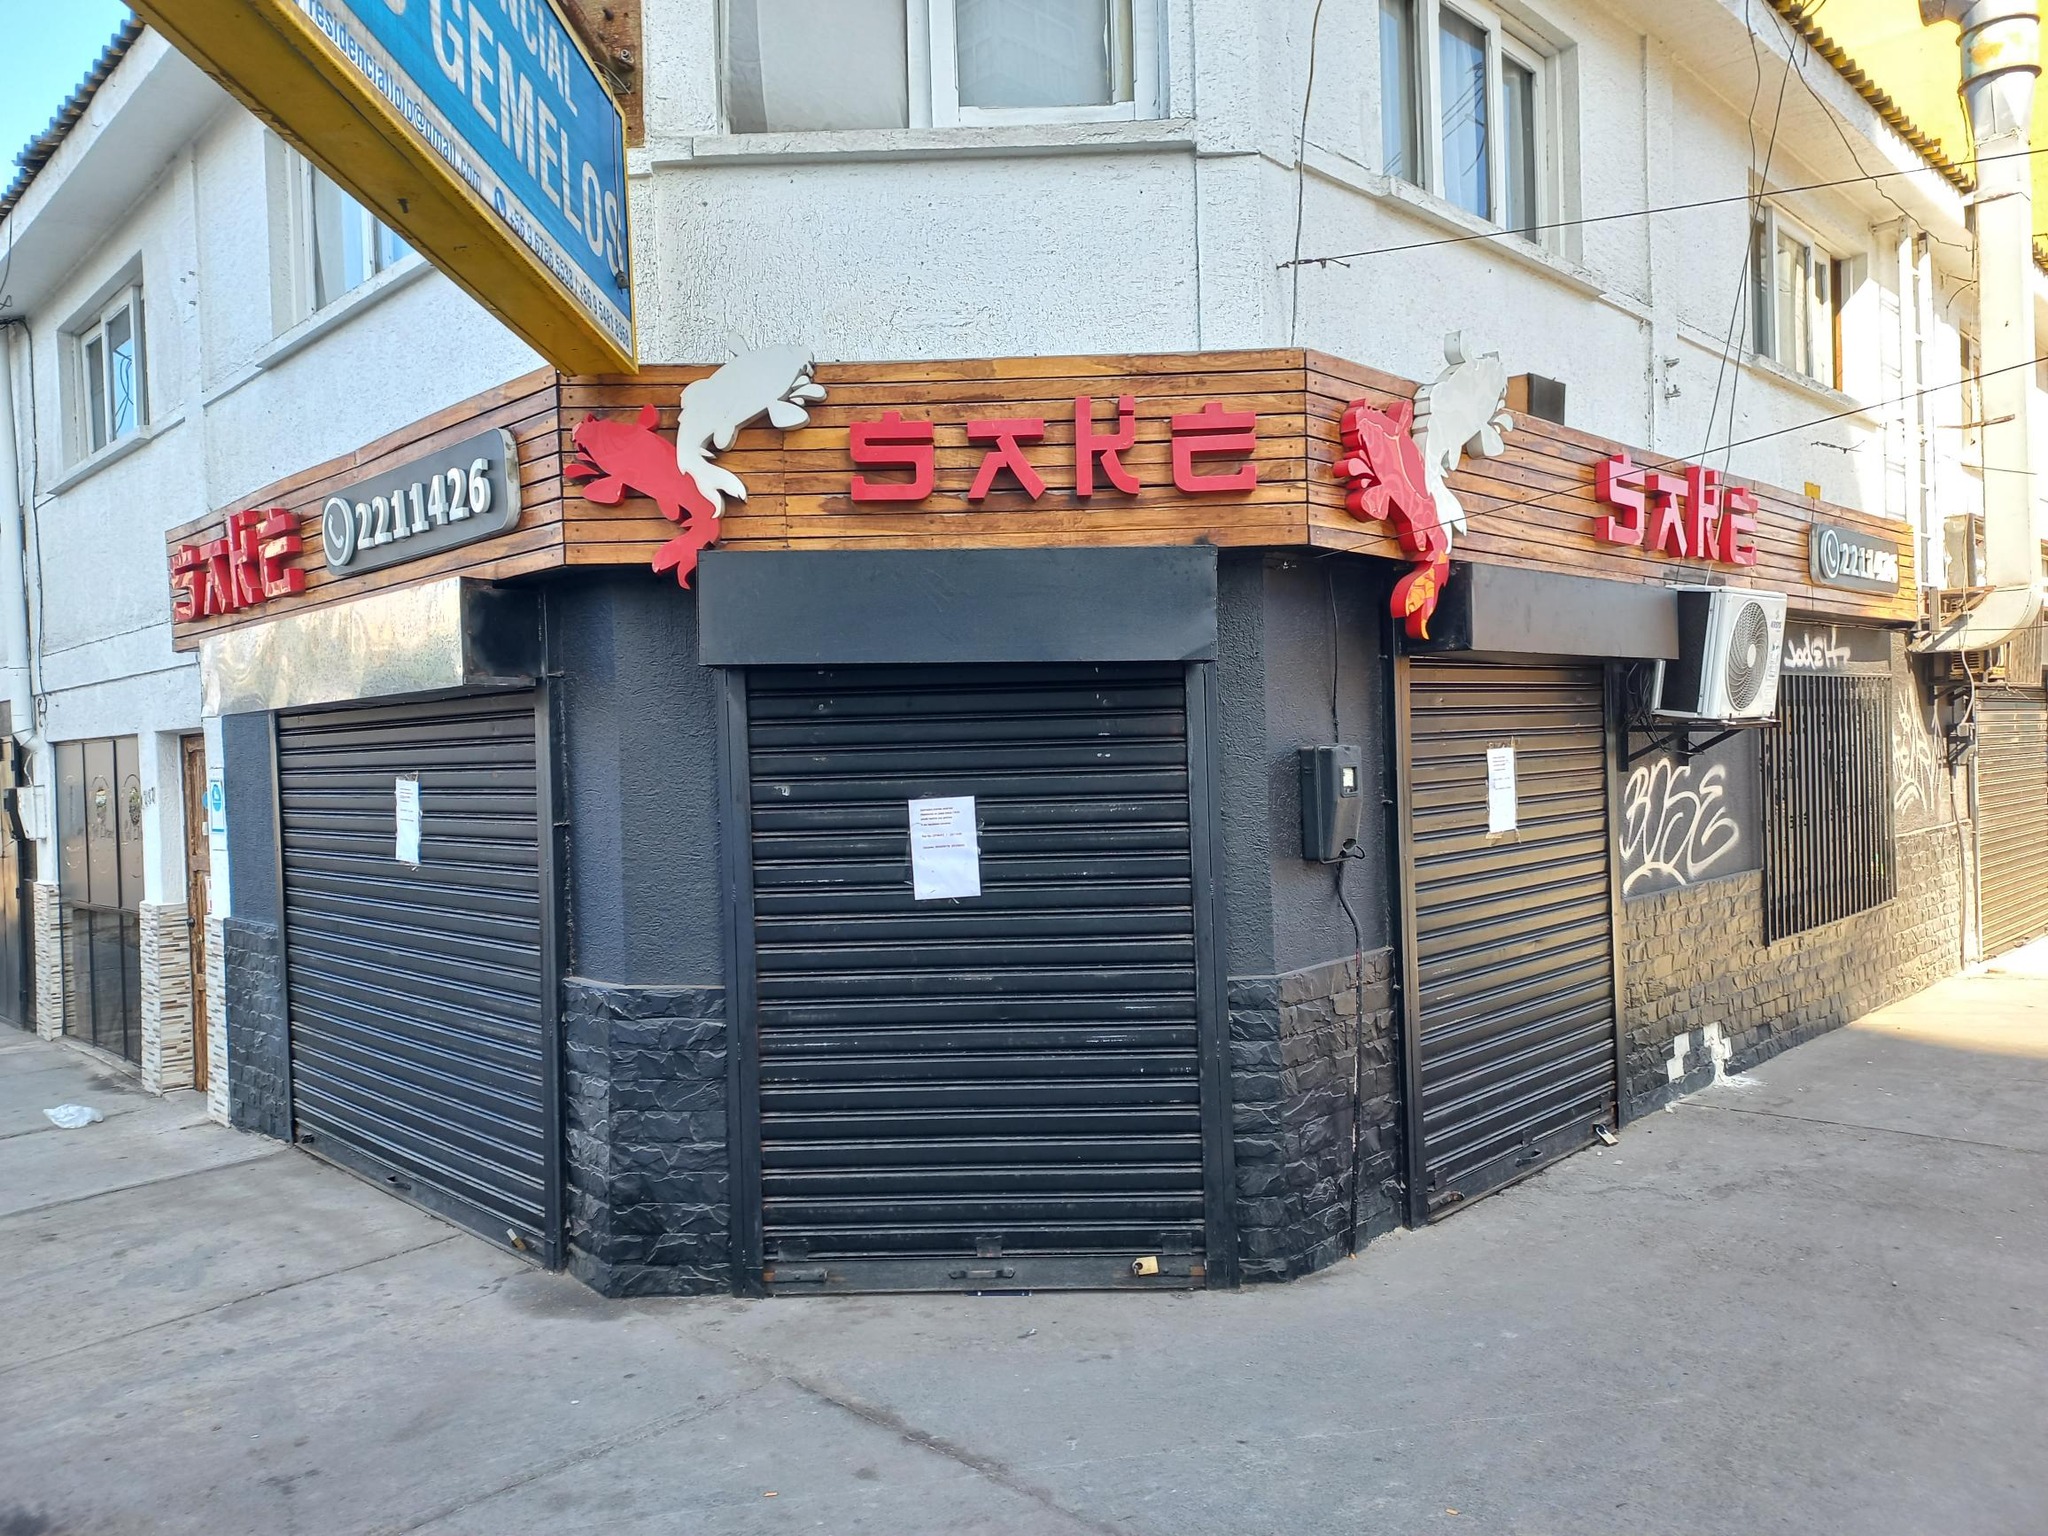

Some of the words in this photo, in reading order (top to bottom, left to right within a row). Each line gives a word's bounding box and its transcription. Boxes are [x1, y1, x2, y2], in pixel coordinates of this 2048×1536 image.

[430, 0, 624, 279] GEMELOS
[355, 458, 491, 550] 2211426
[849, 395, 1257, 501] SAKE
[170, 508, 305, 622] SAKE
[1595, 449, 1759, 567] SAKE
